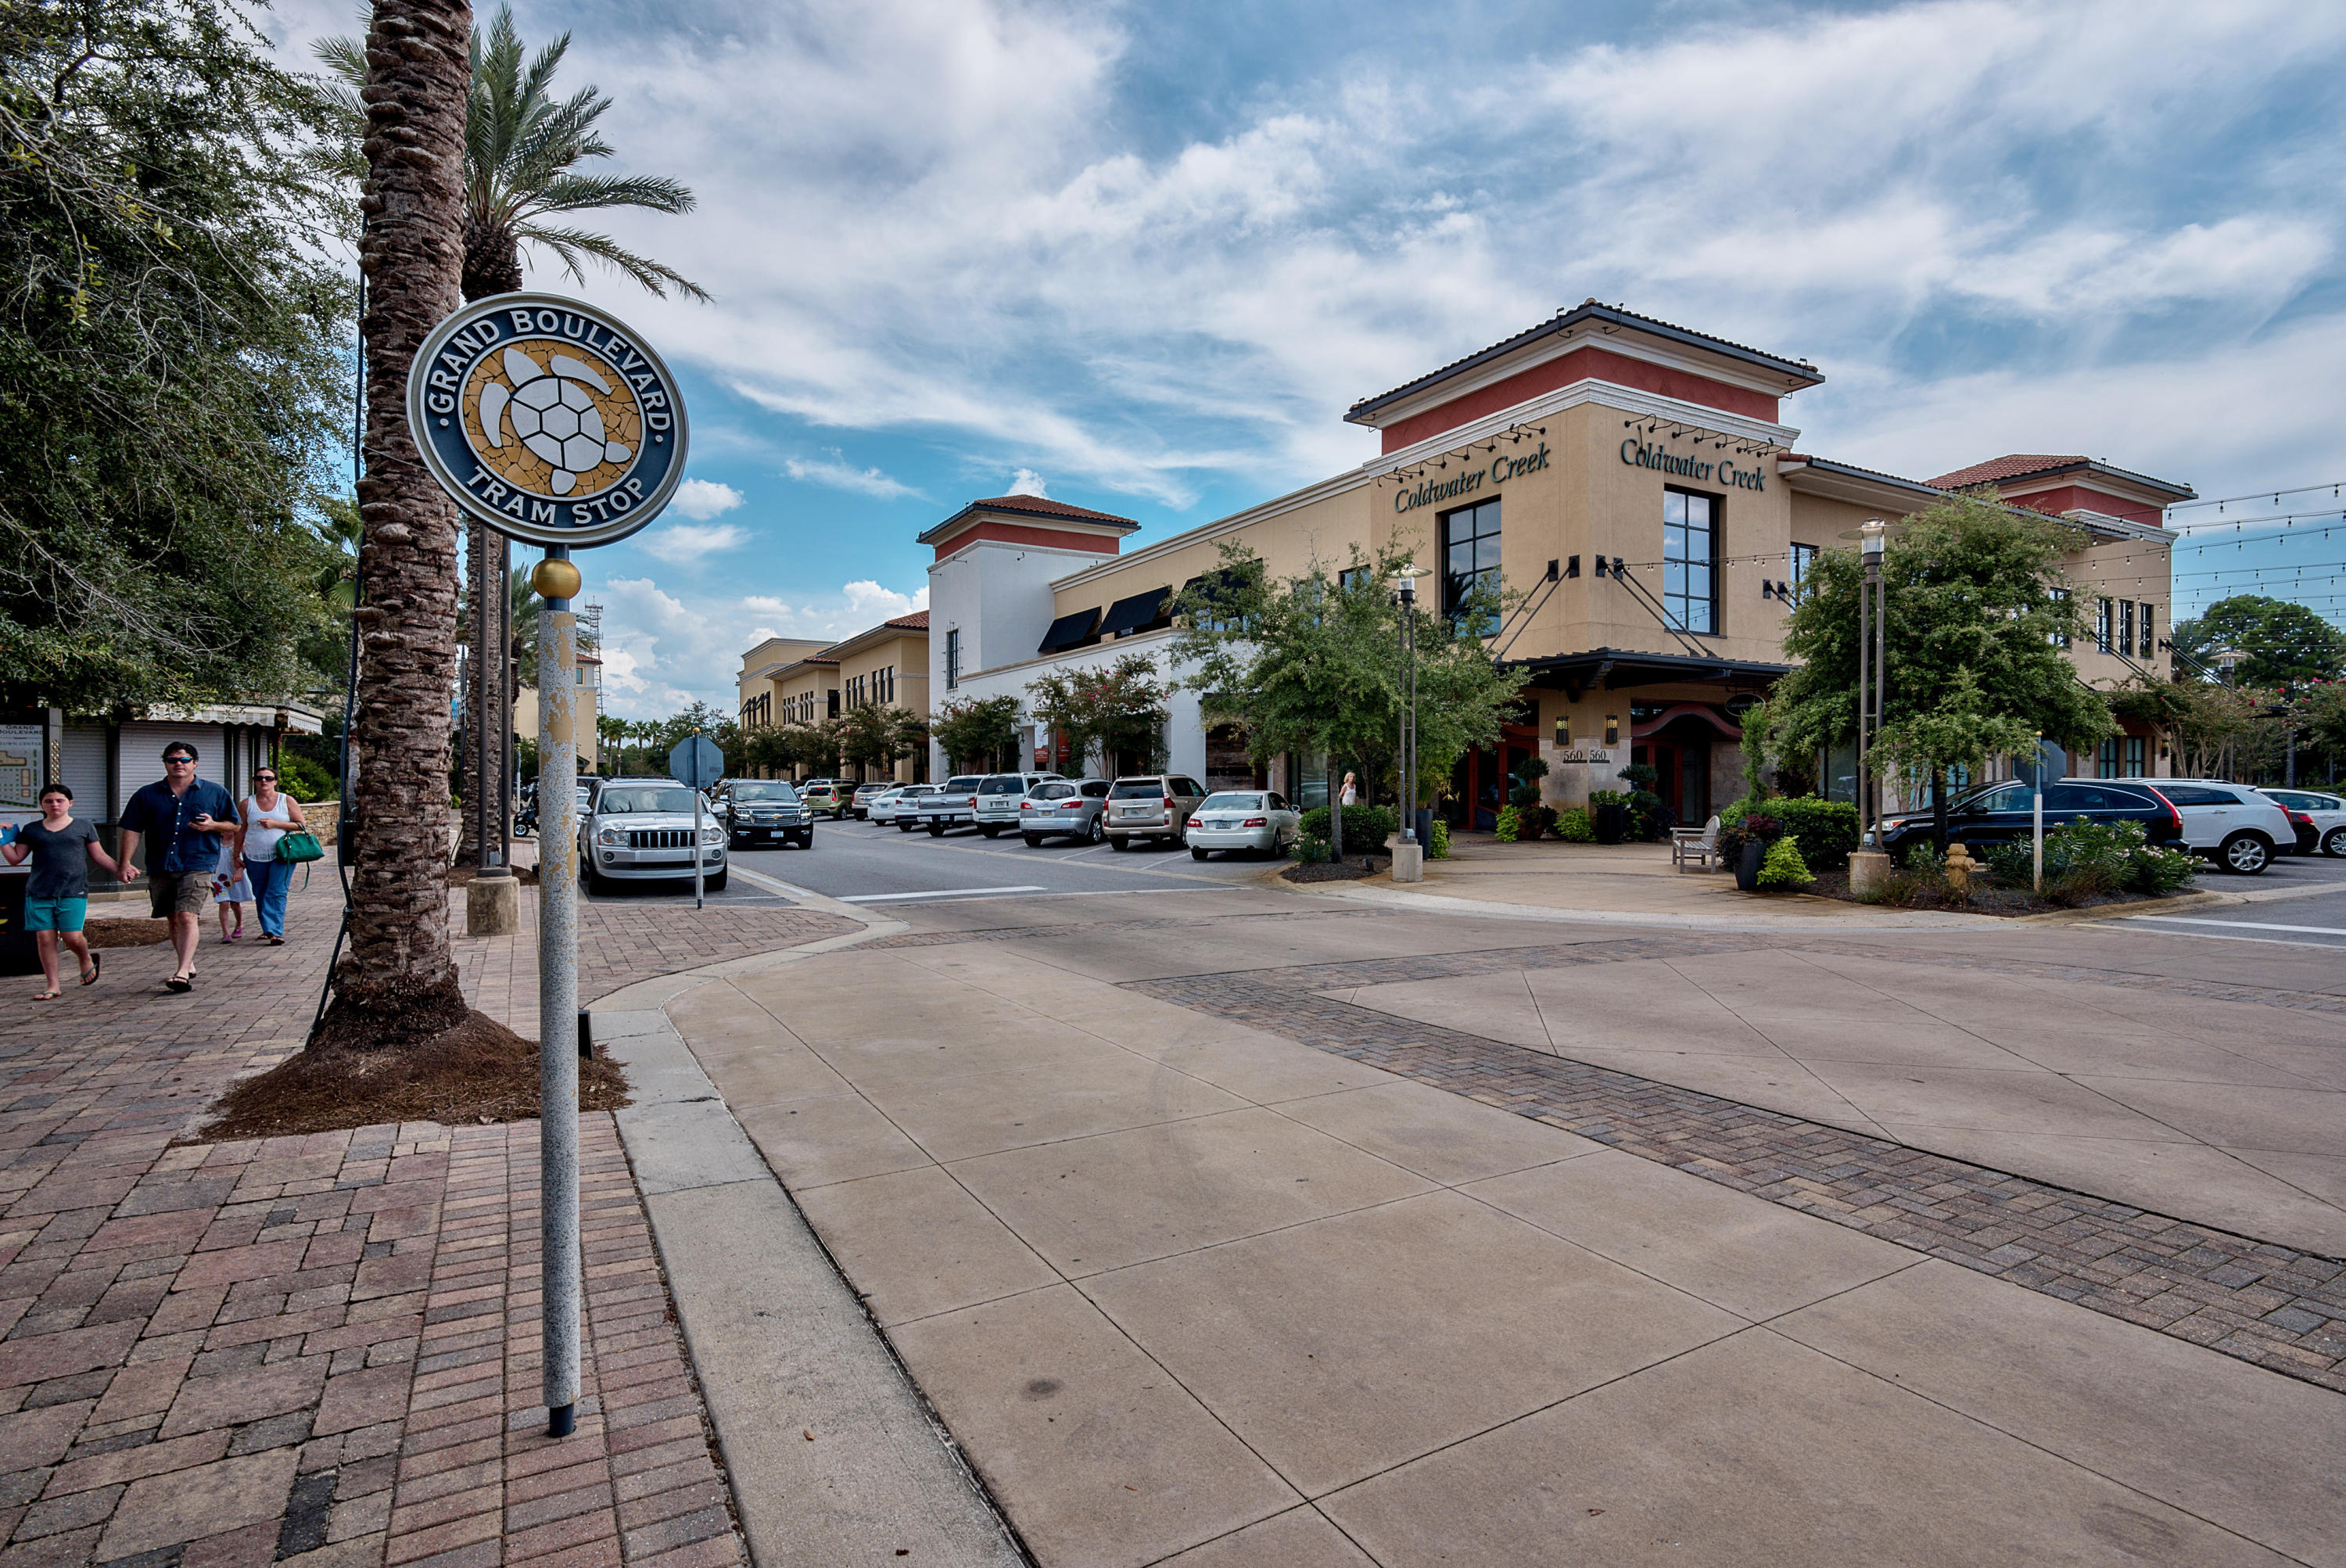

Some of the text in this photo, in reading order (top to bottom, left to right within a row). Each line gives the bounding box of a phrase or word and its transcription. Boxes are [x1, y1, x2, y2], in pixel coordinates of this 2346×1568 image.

[429, 310, 670, 430] GRAND BOULEVARD
[1394, 441, 1551, 513] Coldwater Creek
[1622, 438, 1767, 491] Coldwater Creek
[467, 465, 644, 525] TRAM STOP
[1564, 750, 1583, 761] 560
[1590, 750, 1606, 761] 560
